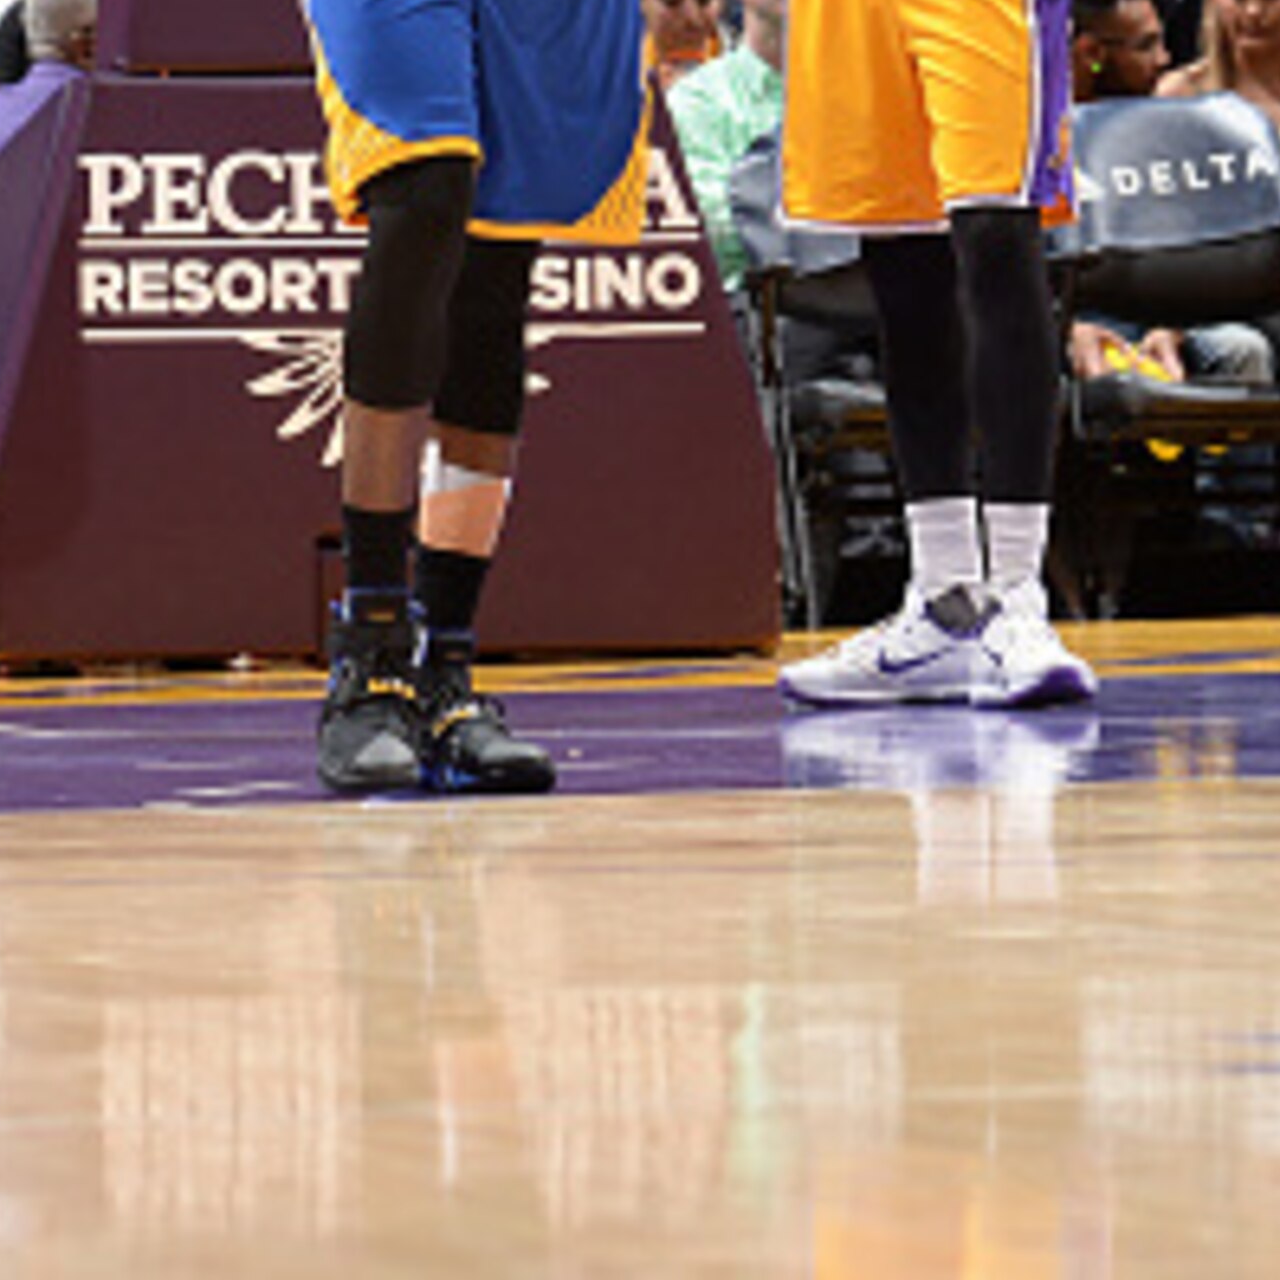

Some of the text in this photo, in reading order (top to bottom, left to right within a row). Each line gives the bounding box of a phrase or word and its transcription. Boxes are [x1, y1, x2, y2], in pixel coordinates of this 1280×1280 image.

[1111, 148, 1277, 196] DELTA
[79, 253, 701, 314] RESORT SINO
